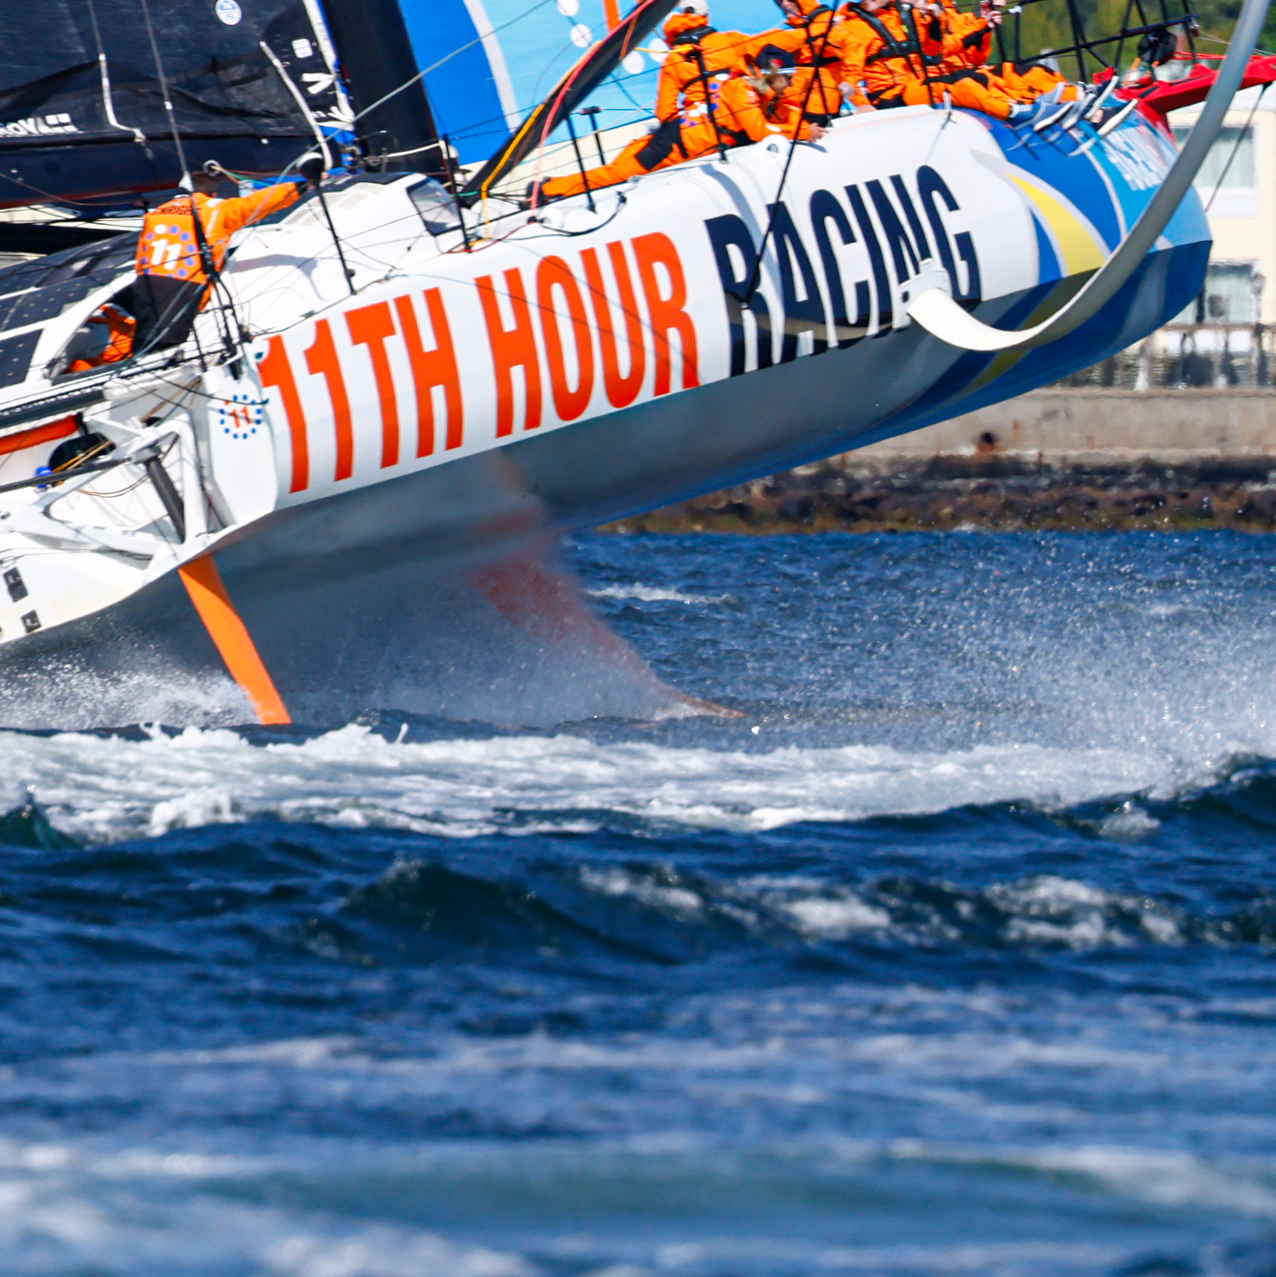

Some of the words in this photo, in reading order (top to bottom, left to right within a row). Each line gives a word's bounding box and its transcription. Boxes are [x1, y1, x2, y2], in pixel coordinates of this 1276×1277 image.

[150, 238, 183, 271] 11
[257, 286, 464, 494] 11TH
[474, 231, 701, 440] HOUR
[704, 164, 982, 377] RACING
[230, 405, 252, 428] 11
